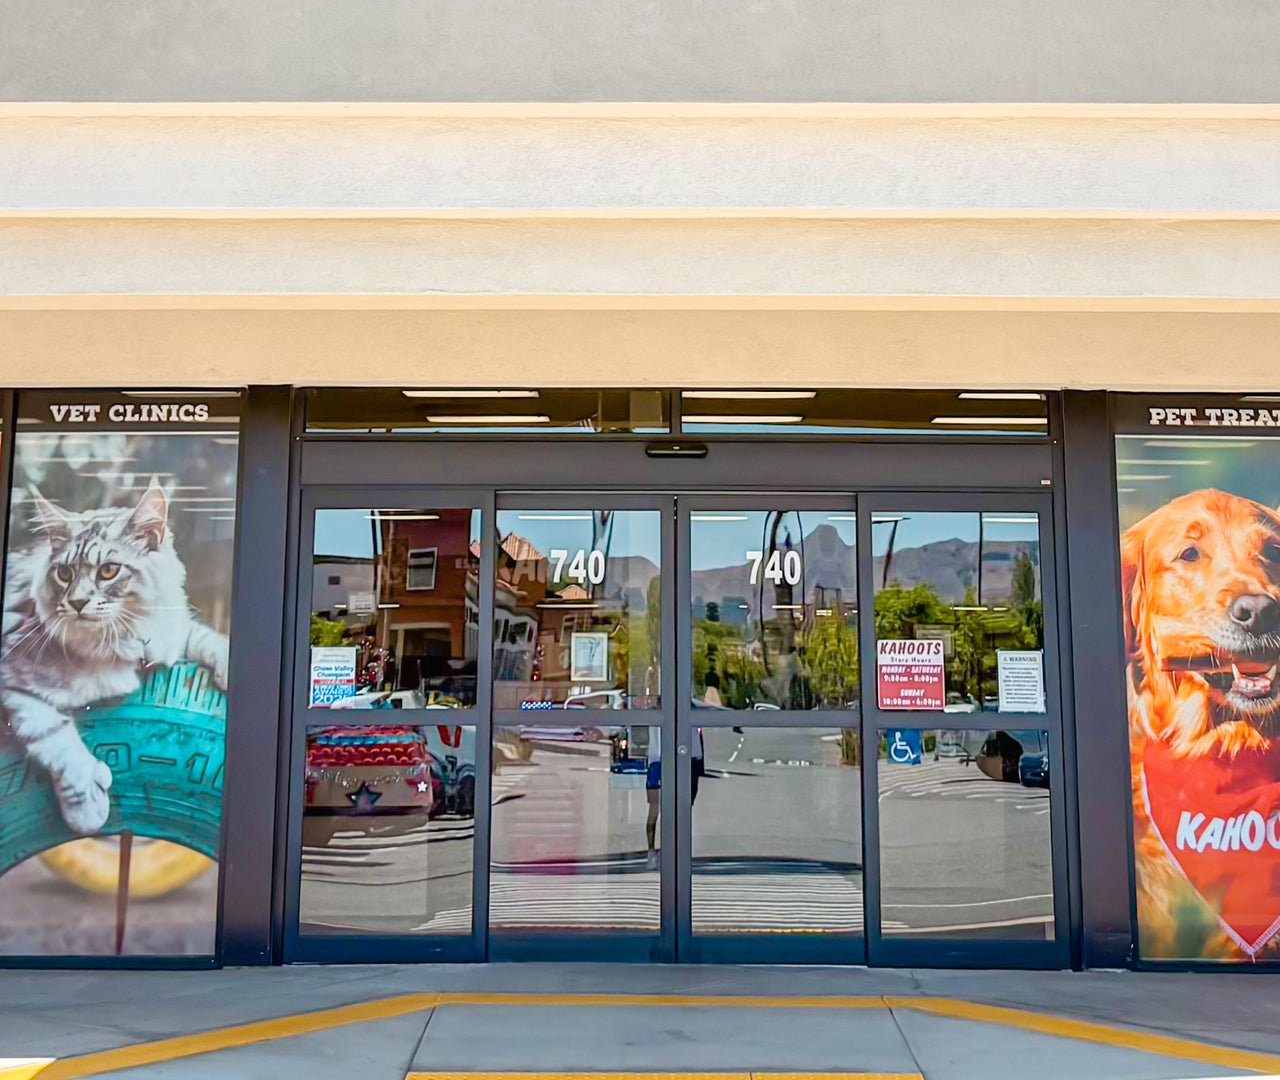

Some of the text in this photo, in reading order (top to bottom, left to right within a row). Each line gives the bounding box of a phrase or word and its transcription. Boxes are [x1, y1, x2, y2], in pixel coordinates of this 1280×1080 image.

[49, 404, 209, 422] VET CLINICS
[1149, 408, 1196, 426] PET
[550, 549, 606, 585] 740
[746, 550, 802, 586] 740
[880, 642, 941, 655] KAHOOTS
[881, 666, 906, 674] MONDAY
[911, 666, 941, 674] SATURDAY
[900, 689, 925, 697] SUNDAY
